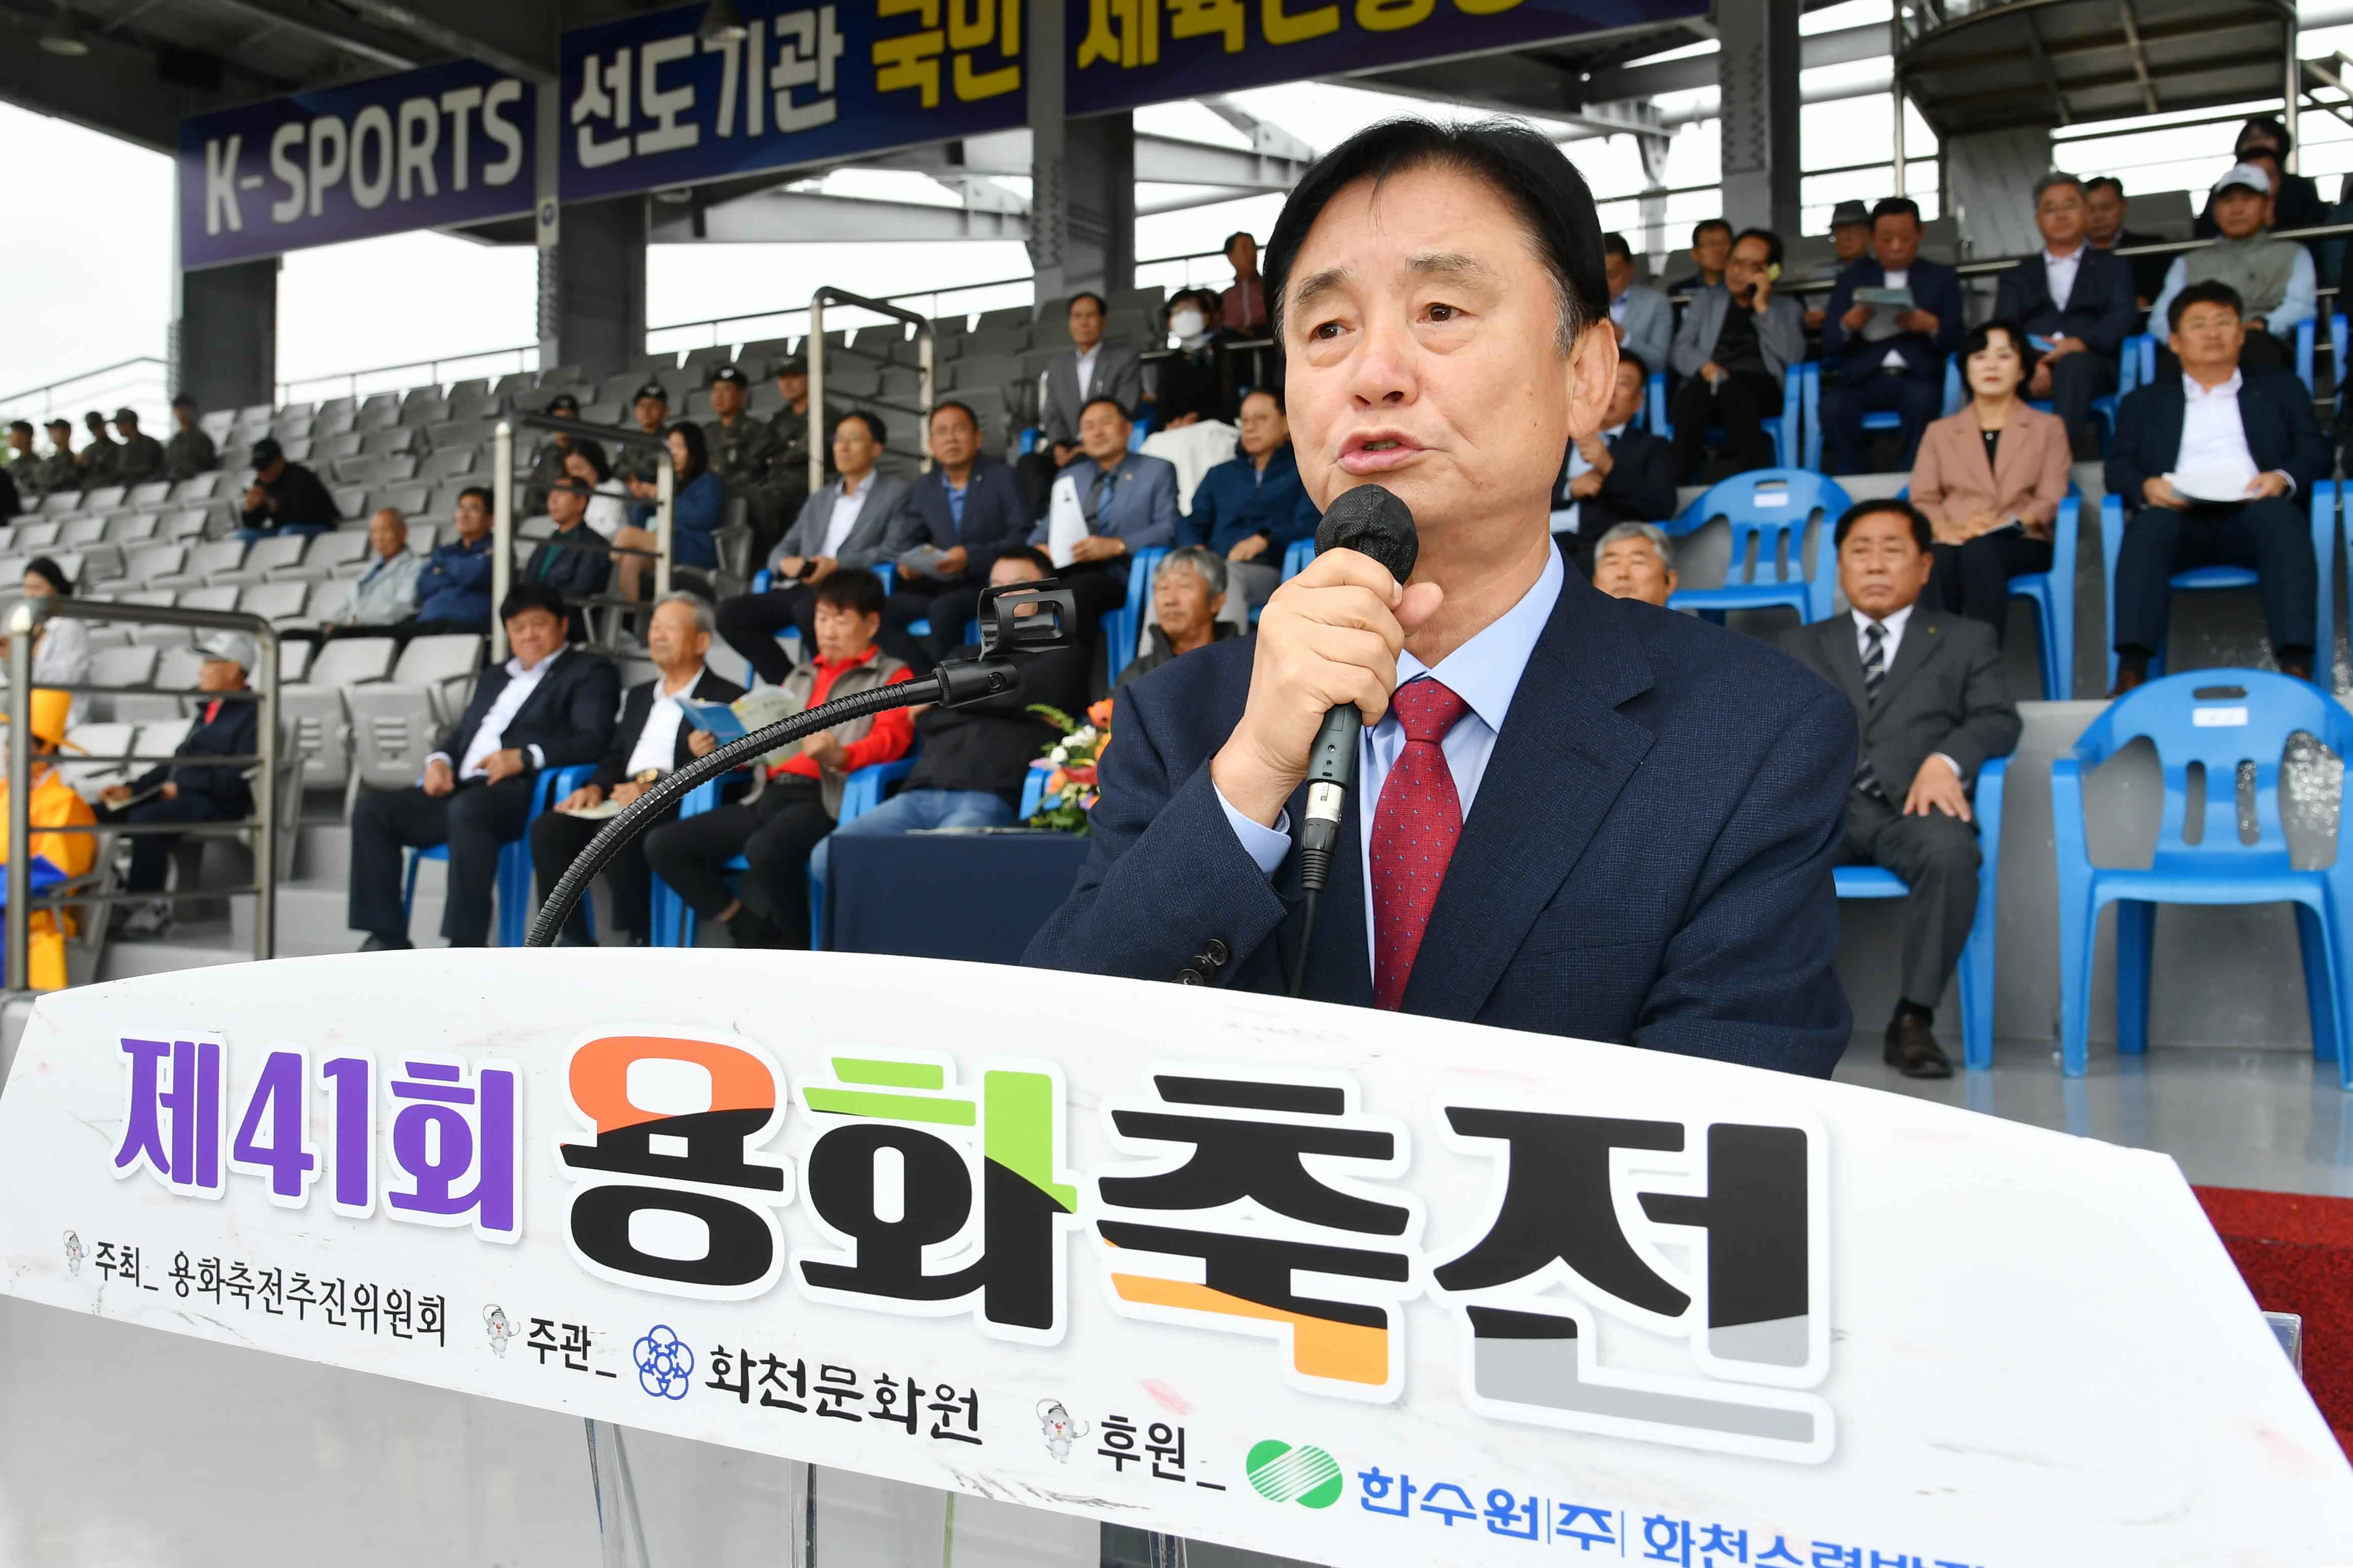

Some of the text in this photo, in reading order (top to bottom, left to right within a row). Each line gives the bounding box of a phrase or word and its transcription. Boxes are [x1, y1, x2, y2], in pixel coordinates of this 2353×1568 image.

[206, 79, 523, 236] K-SPORTS
[571, 5, 844, 169] 선도기관
[873, 0, 1020, 108] 국민
[115, 1035, 1813, 1443] 제41회 용화축전
[168, 1250, 445, 1347] 용화축전추진위원회
[705, 1344, 983, 1446] 화천문화원
